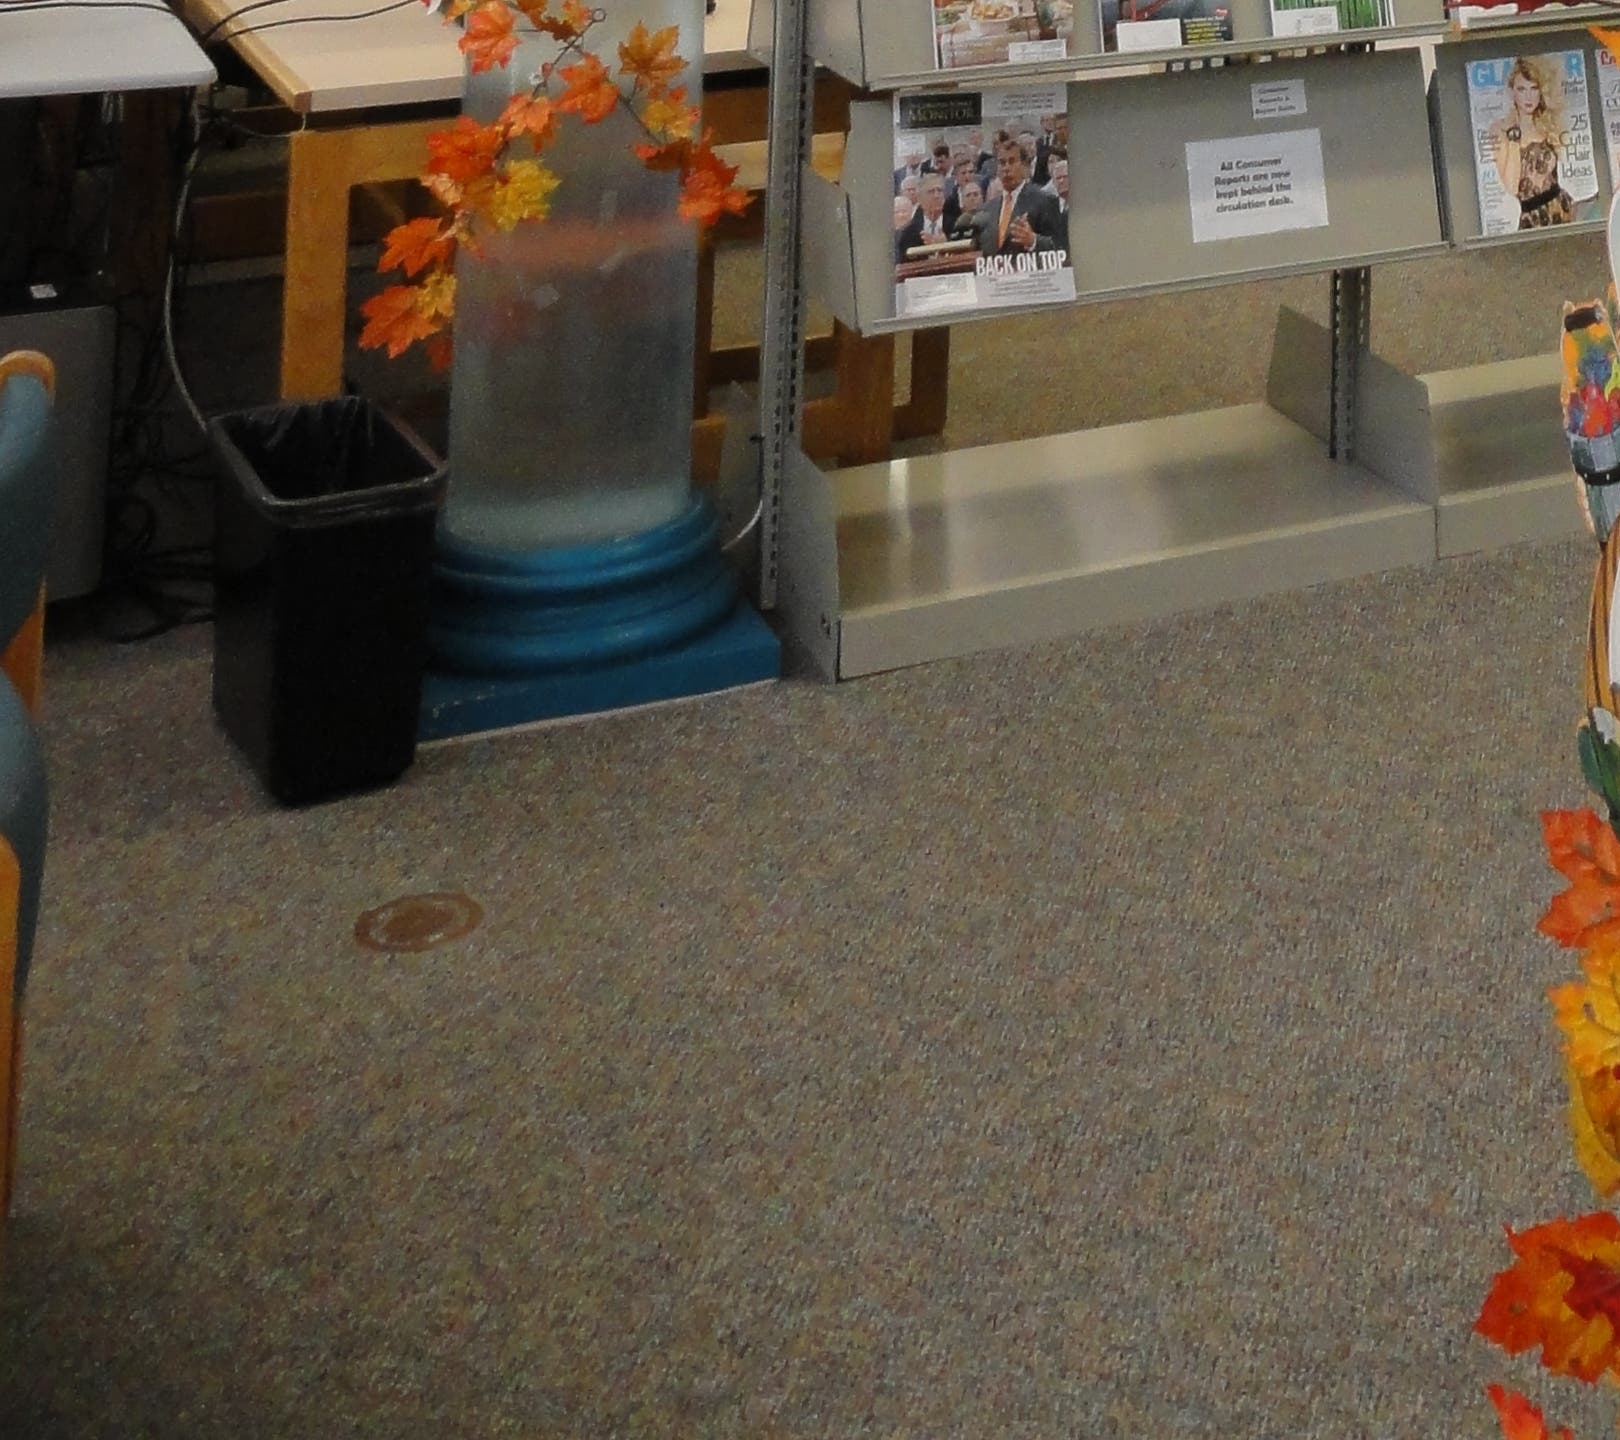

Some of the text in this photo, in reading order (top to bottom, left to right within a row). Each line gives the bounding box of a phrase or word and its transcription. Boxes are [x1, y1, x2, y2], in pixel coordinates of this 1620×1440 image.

[1570, 114, 1588, 132] 25
[1558, 130, 1591, 147] Cute
[1565, 144, 1591, 163] Hair
[1220, 156, 1283, 172] All Consumer
[1561, 162, 1594, 180] Ideas
[1214, 170, 1291, 188] Reports are now
[1216, 182, 1292, 201] kept behind the
[1216, 198, 1266, 214] circulation
[975, 249, 1068, 277] BACK ON TOP
